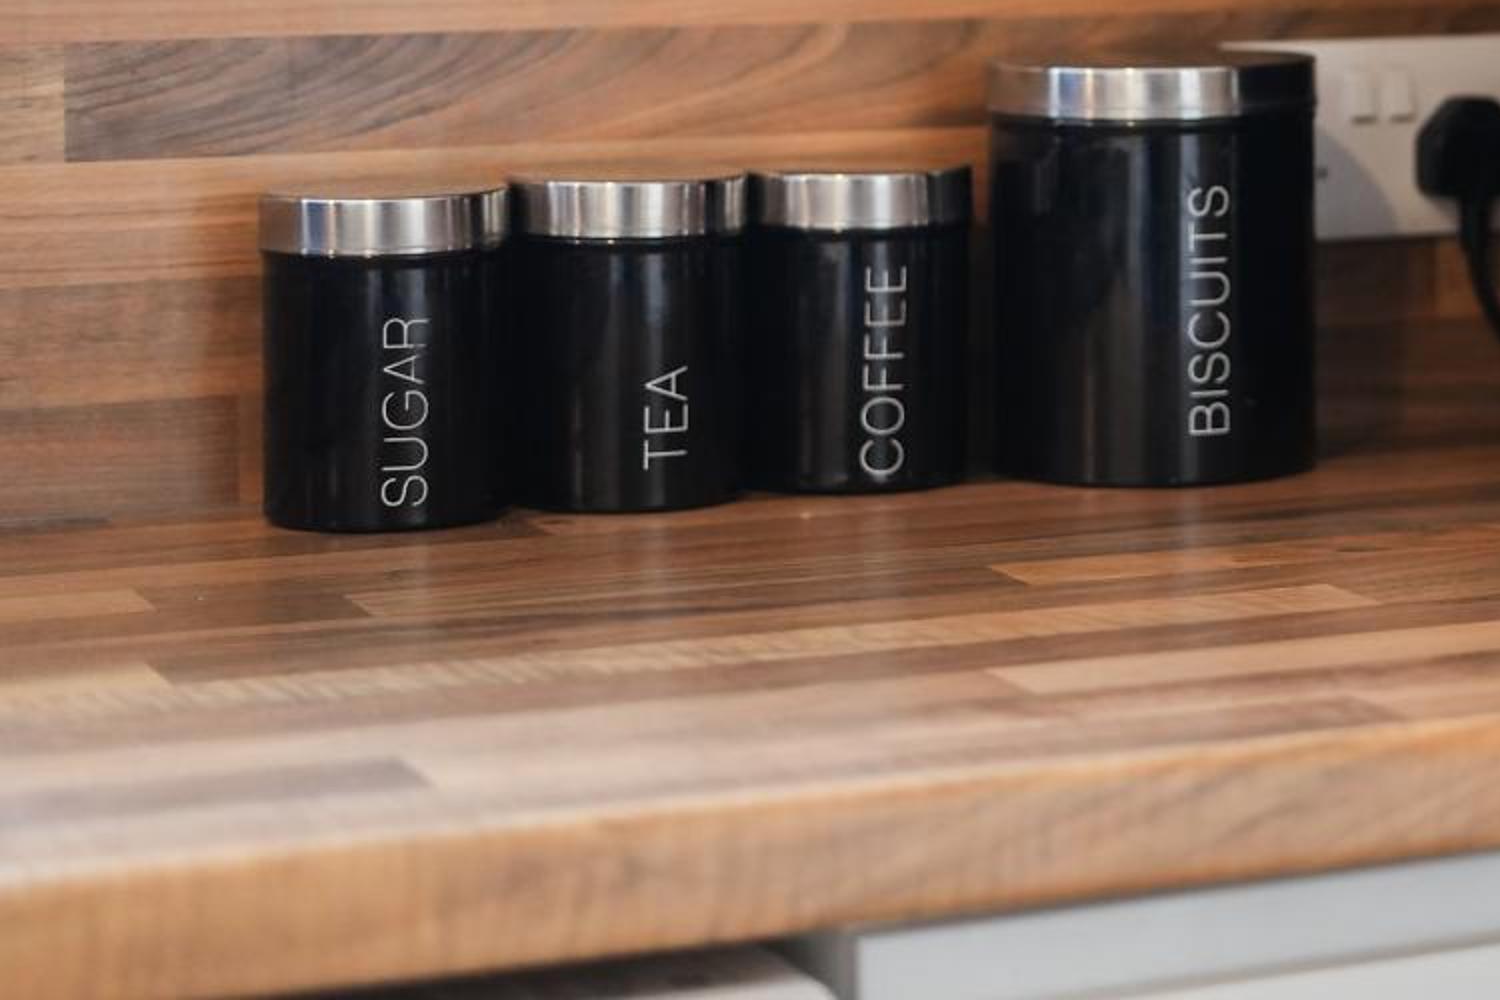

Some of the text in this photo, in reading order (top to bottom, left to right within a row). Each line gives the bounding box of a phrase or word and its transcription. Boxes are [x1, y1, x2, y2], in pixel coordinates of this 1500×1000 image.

[860, 266, 907, 473] COFFEE
[1187, 185, 1231, 436] BISCUITS
[381, 318, 430, 507] SUGAR
[643, 365, 688, 470] TEA
